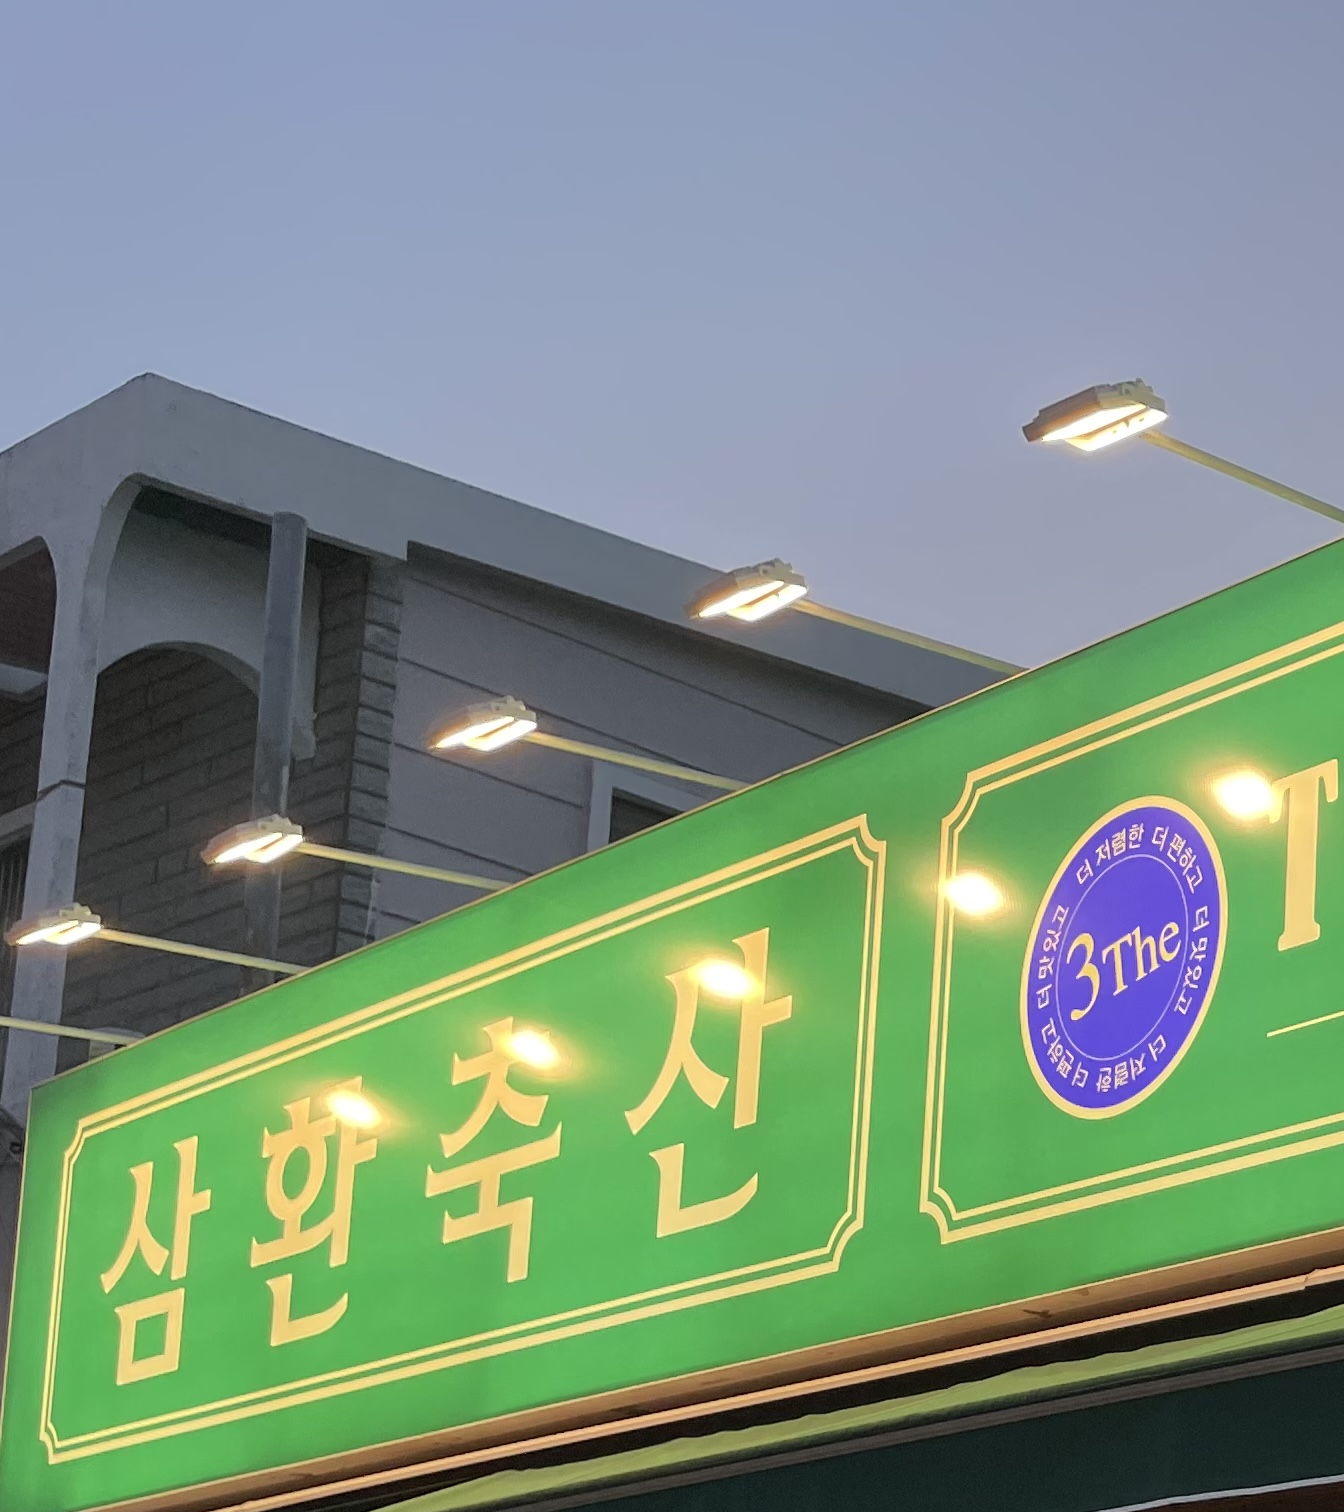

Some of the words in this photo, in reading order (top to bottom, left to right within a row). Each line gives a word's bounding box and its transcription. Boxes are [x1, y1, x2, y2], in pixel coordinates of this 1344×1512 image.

[1076, 858, 1095, 885] 더
[1095, 822, 1146, 866] 저렴한
[1151, 825, 1169, 853] 더
[1169, 832, 1204, 894] 편하고
[1193, 906, 1210, 933] 더
[1036, 983, 1053, 1010] 더
[1148, 1033, 1168, 1063] 더
[1071, 1061, 1089, 1089] 더
[100, 928, 793, 1386] 삼환축산
